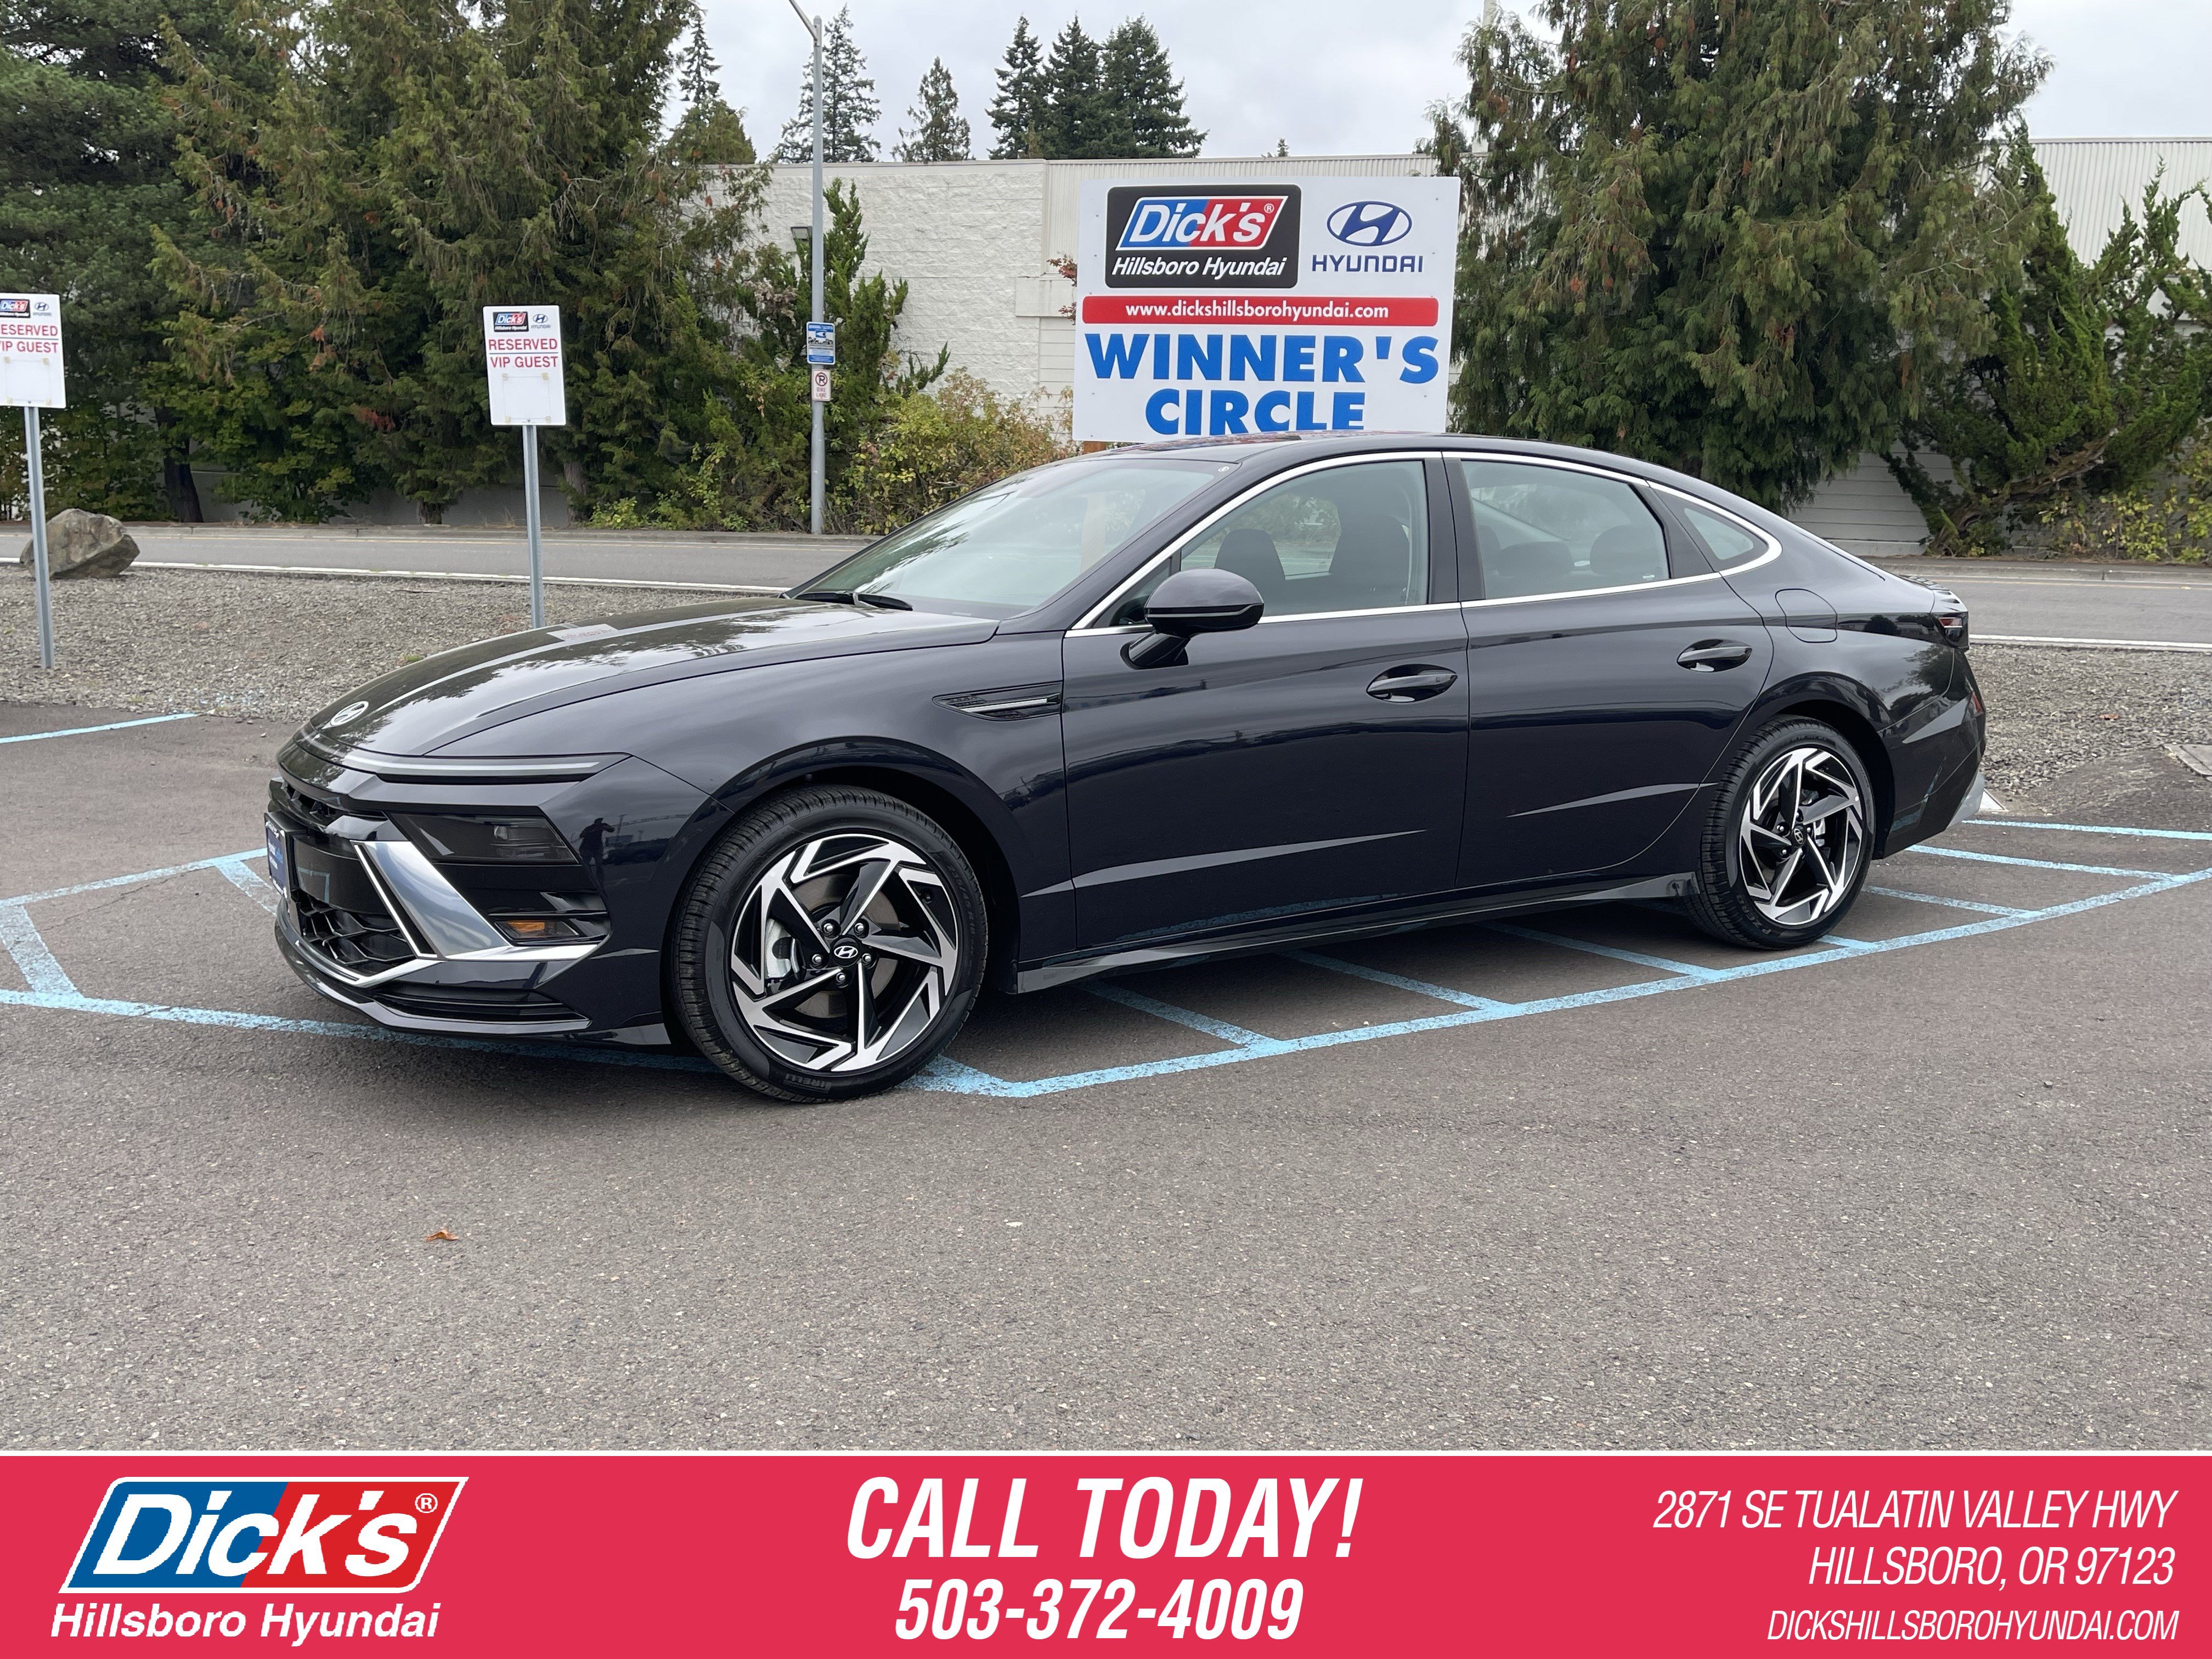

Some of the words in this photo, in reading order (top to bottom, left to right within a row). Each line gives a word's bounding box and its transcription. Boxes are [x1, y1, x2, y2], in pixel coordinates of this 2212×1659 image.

[1129, 202, 1265, 244] Dick's
[1111, 257, 1199, 275] Hillsboro
[1202, 257, 1288, 280] Hyundai
[1312, 255, 1423, 273] HYUNDAI
[1125, 300, 1389, 322] www.dickshillsborohyundai.com
[0, 324, 58, 336] ESERVED
[0, 340, 13, 352] IP
[16, 341, 59, 354] GUEST
[488, 338, 558, 351] RESERVED
[490, 356, 510, 368] VIP
[514, 356, 558, 368] GUEST
[1084, 333, 1439, 384] WINNER'S
[1145, 388, 1365, 436] CIRCLE
